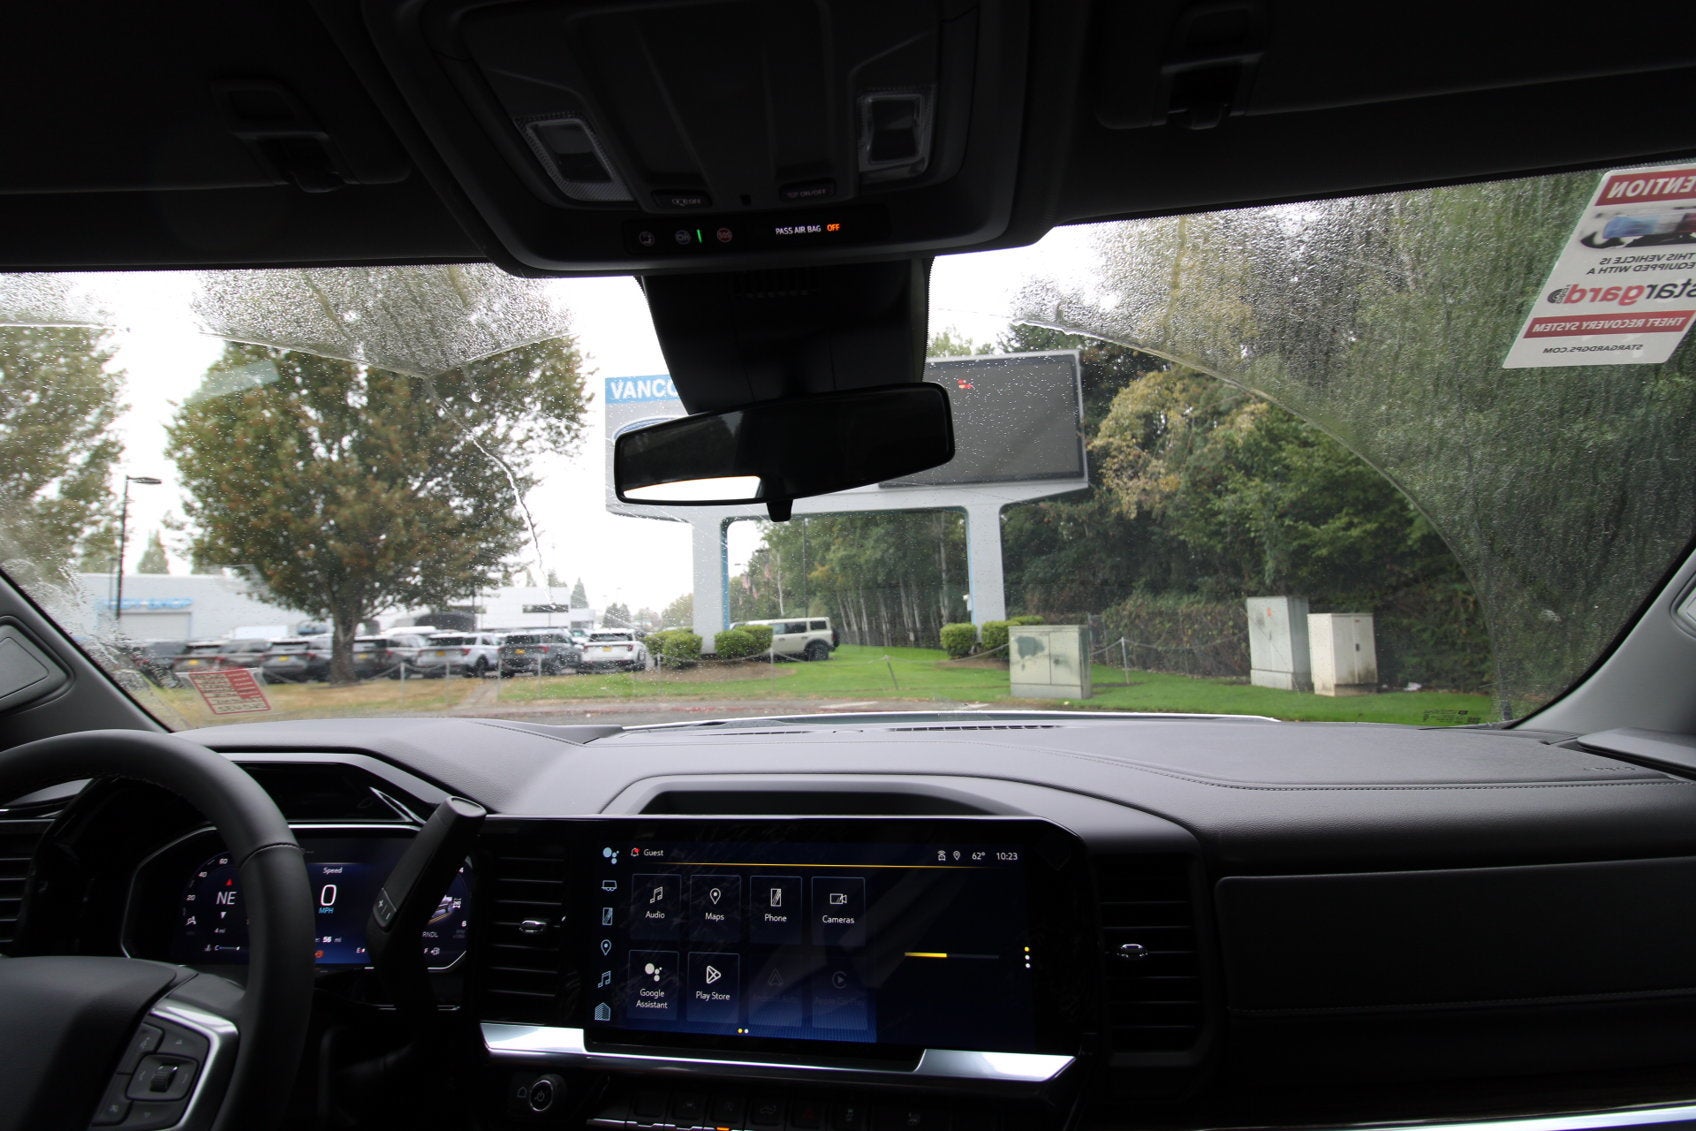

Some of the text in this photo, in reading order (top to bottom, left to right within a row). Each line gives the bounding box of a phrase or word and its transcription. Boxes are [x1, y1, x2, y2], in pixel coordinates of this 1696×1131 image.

[775, 223, 841, 235] PASS AIR BAG OFF
[643, 849, 664, 857] Guest
[996, 852, 1018, 861] 10:23
[322, 867, 343, 875] Speed
[216, 891, 237, 905] NE
[320, 884, 337, 906] 0
[645, 911, 665, 919] Audio
[705, 913, 725, 921] Maps
[764, 913, 787, 923] Phone
[822, 915, 855, 924] Cameras
[639, 988, 665, 998] Google
[696, 991, 730, 1001] Play Store
[636, 1000, 668, 1009] Assistant
